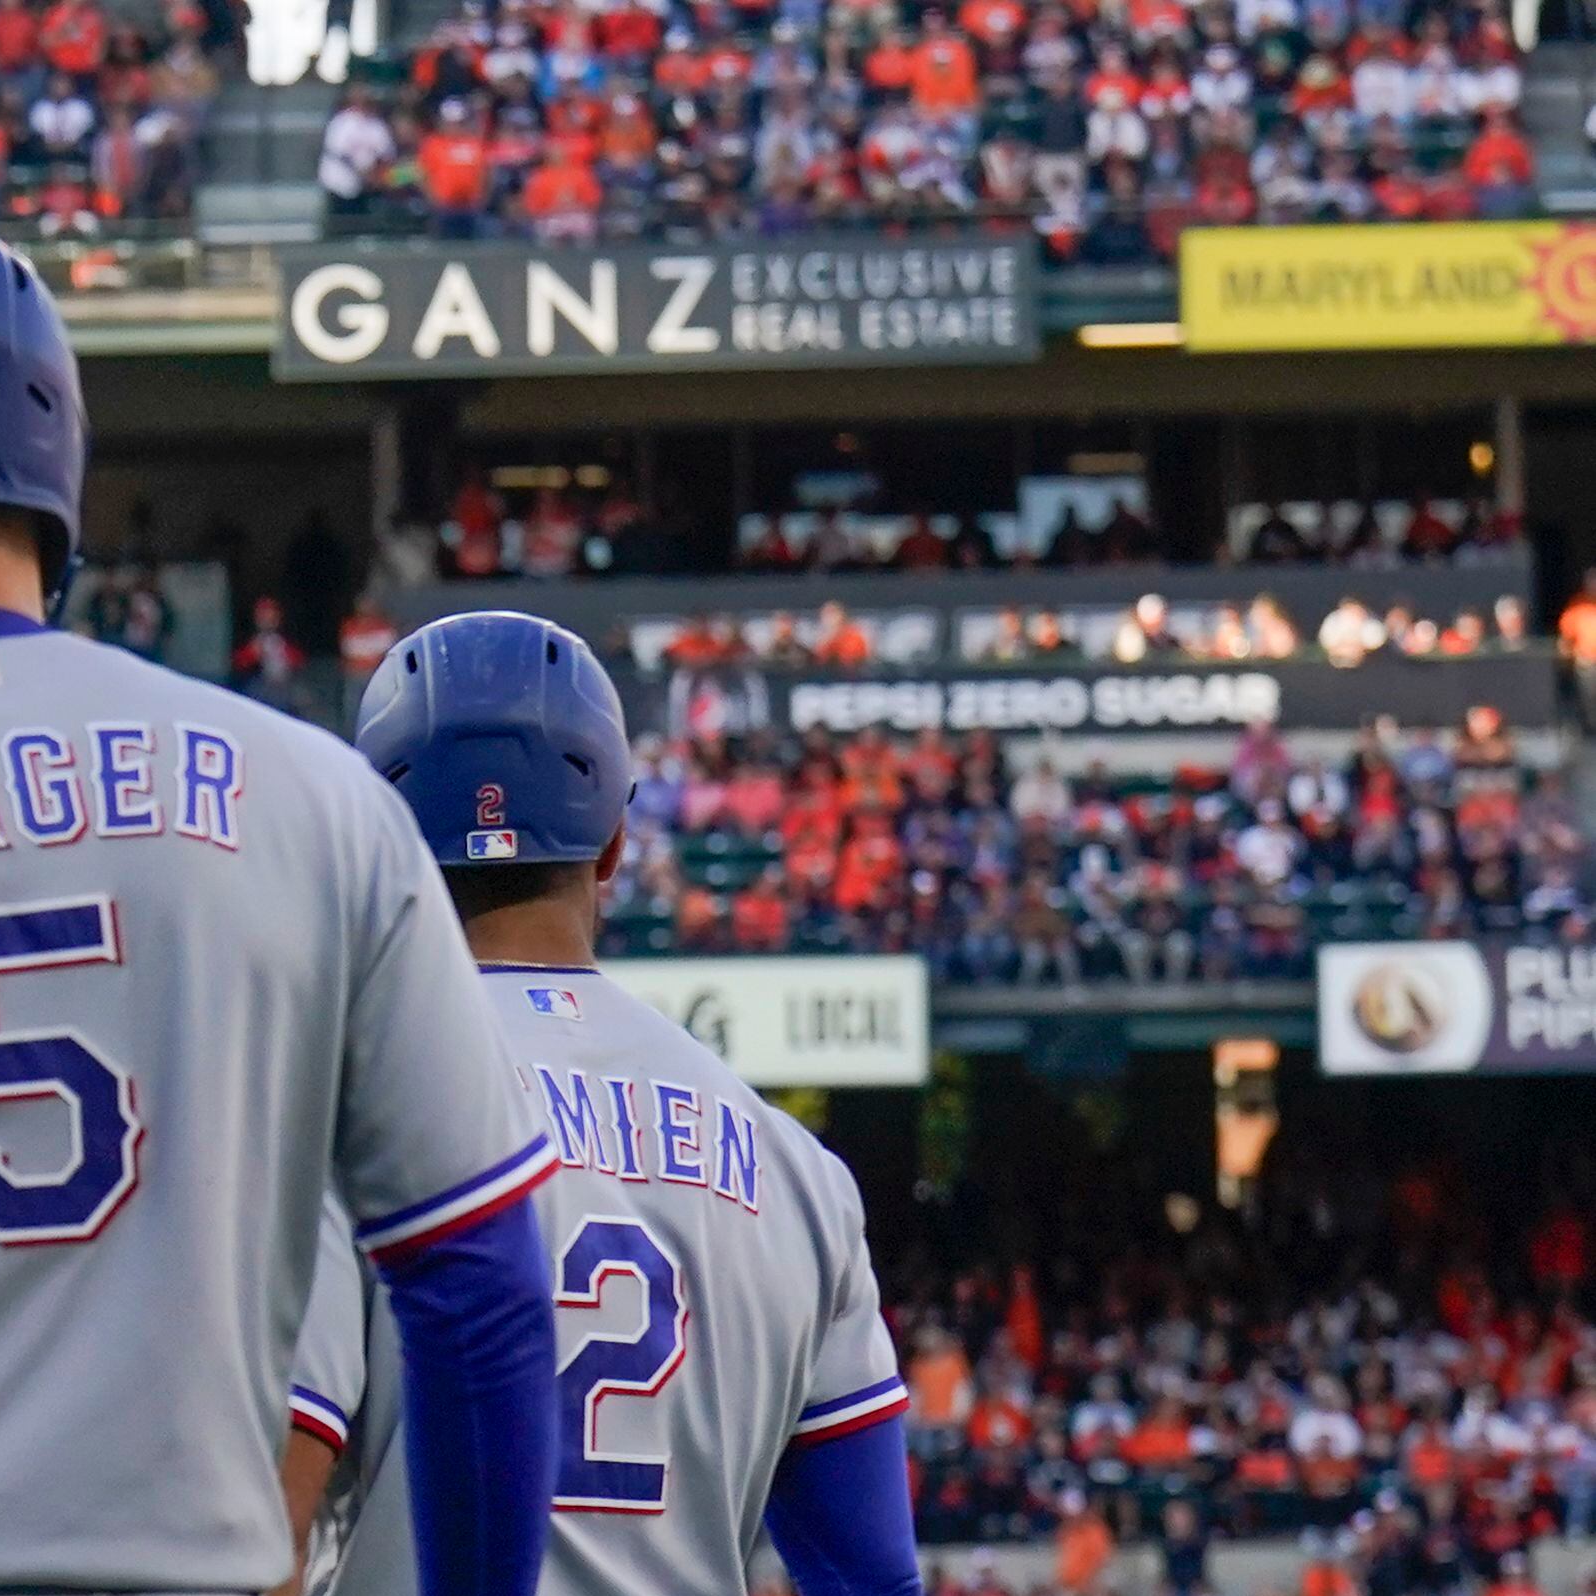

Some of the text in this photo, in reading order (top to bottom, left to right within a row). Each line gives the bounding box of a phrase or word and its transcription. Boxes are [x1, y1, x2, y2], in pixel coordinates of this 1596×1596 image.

[731, 247, 1017, 300] EXCLUSIVE
[1220, 258, 1523, 311] MARYLAND
[291, 255, 722, 364] GANZ
[731, 297, 1017, 351] REAL ESTATE
[790, 671, 1281, 732] PEPSI ZERO SUGAR
[476, 784, 504, 826] 2
[785, 993, 903, 1049] LOCAL
[532, 1062, 760, 1217] MIEN
[554, 1213, 689, 1515] 2
